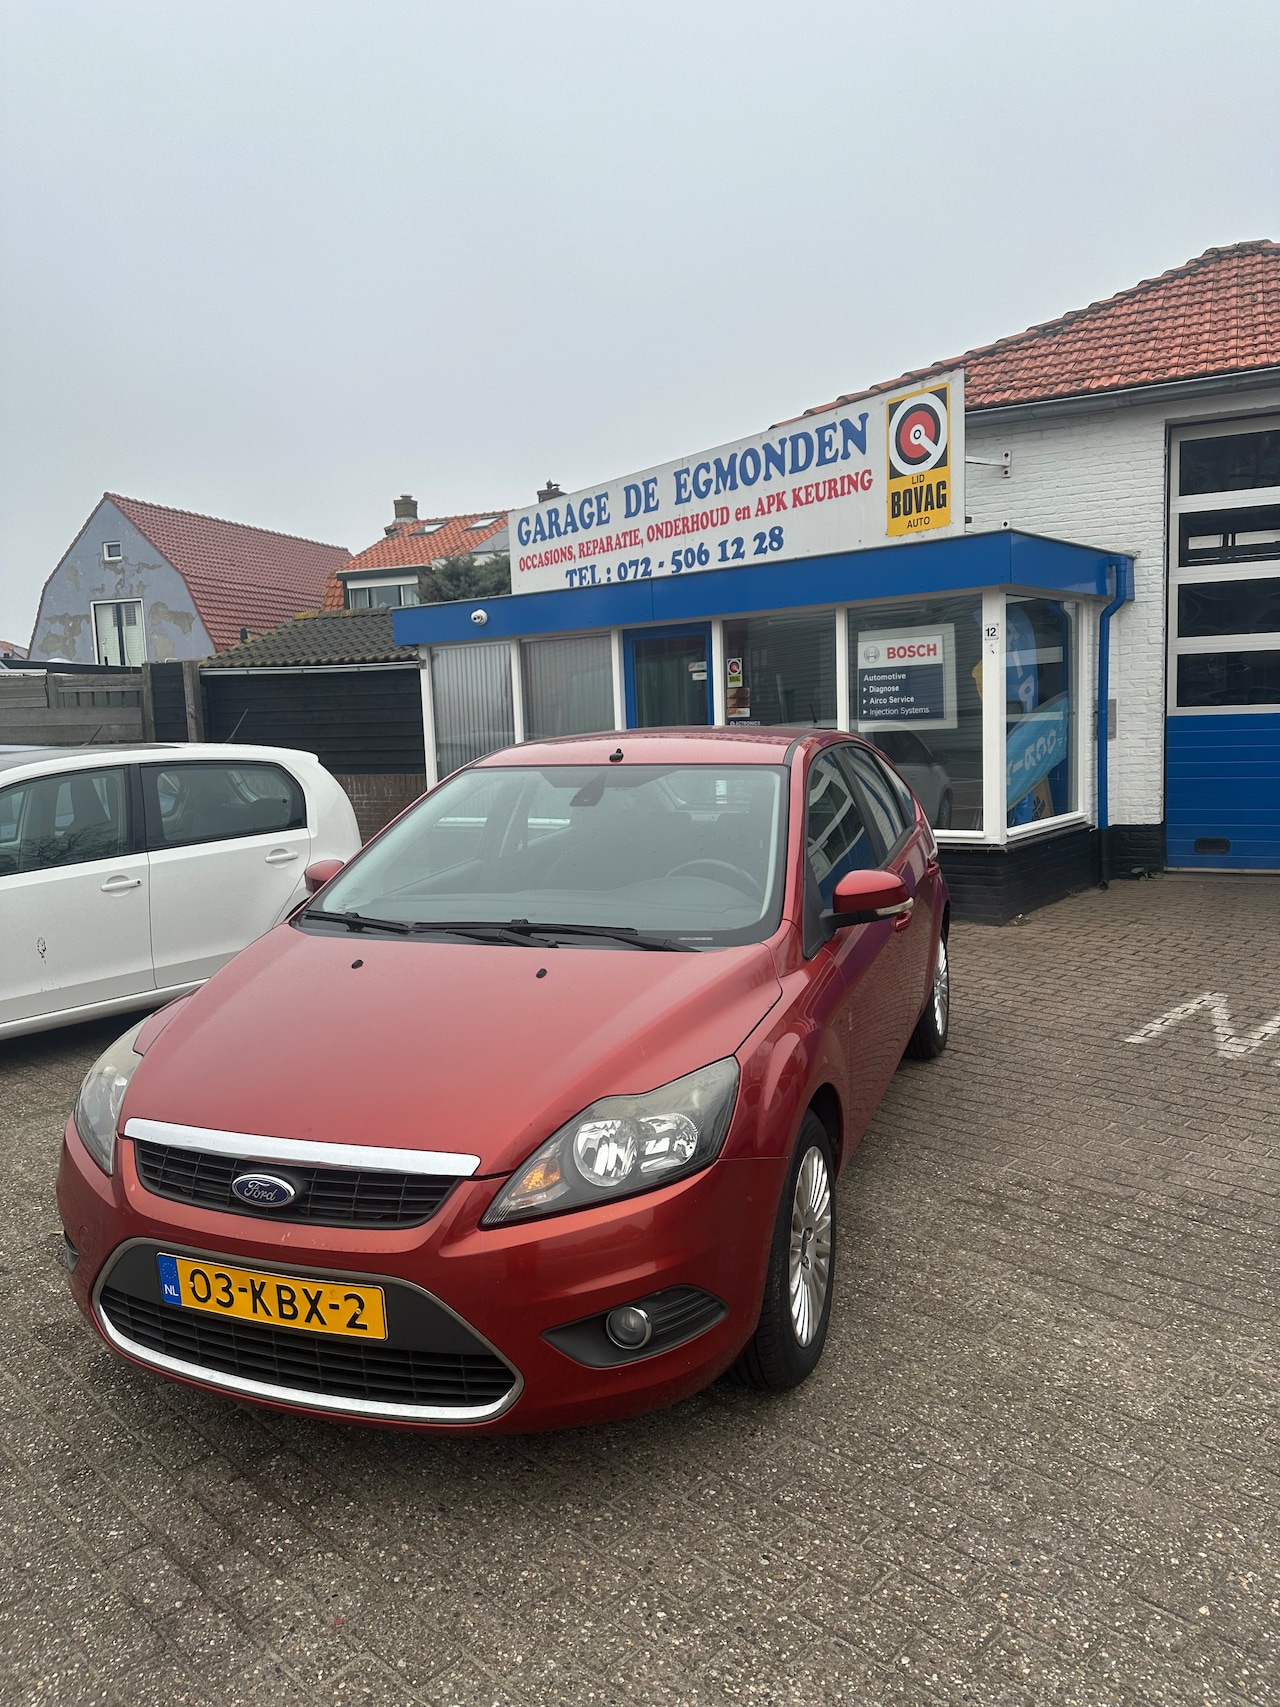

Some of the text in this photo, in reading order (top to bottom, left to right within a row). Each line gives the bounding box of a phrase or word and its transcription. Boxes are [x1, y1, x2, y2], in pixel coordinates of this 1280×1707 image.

[517, 412, 869, 546] GARAGE DE EGMONDEN
[911, 473, 925, 485] LID
[891, 480, 947, 519] BOVAG
[518, 469, 873, 572] OCCASIONS, REPARATIE, ONDERHOUD en APK KEURING
[906, 516, 931, 529] AUTO
[617, 557, 653, 581] 072
[670, 542, 710, 574] 506
[717, 536, 746, 563] 12
[752, 526, 785, 555] 28
[984, 627, 998, 637] 12
[886, 643, 937, 660] BOSCH
[863, 672, 907, 682] Automotive
[869, 685, 900, 694] Diagnose
[869, 695, 915, 705] Airco Service
[869, 706, 930, 717] Injection Systems
[243, 1180, 278, 1201] Ford
[164, 1283, 179, 1297] NL
[189, 1267, 368, 1331] 03-KBX-2
